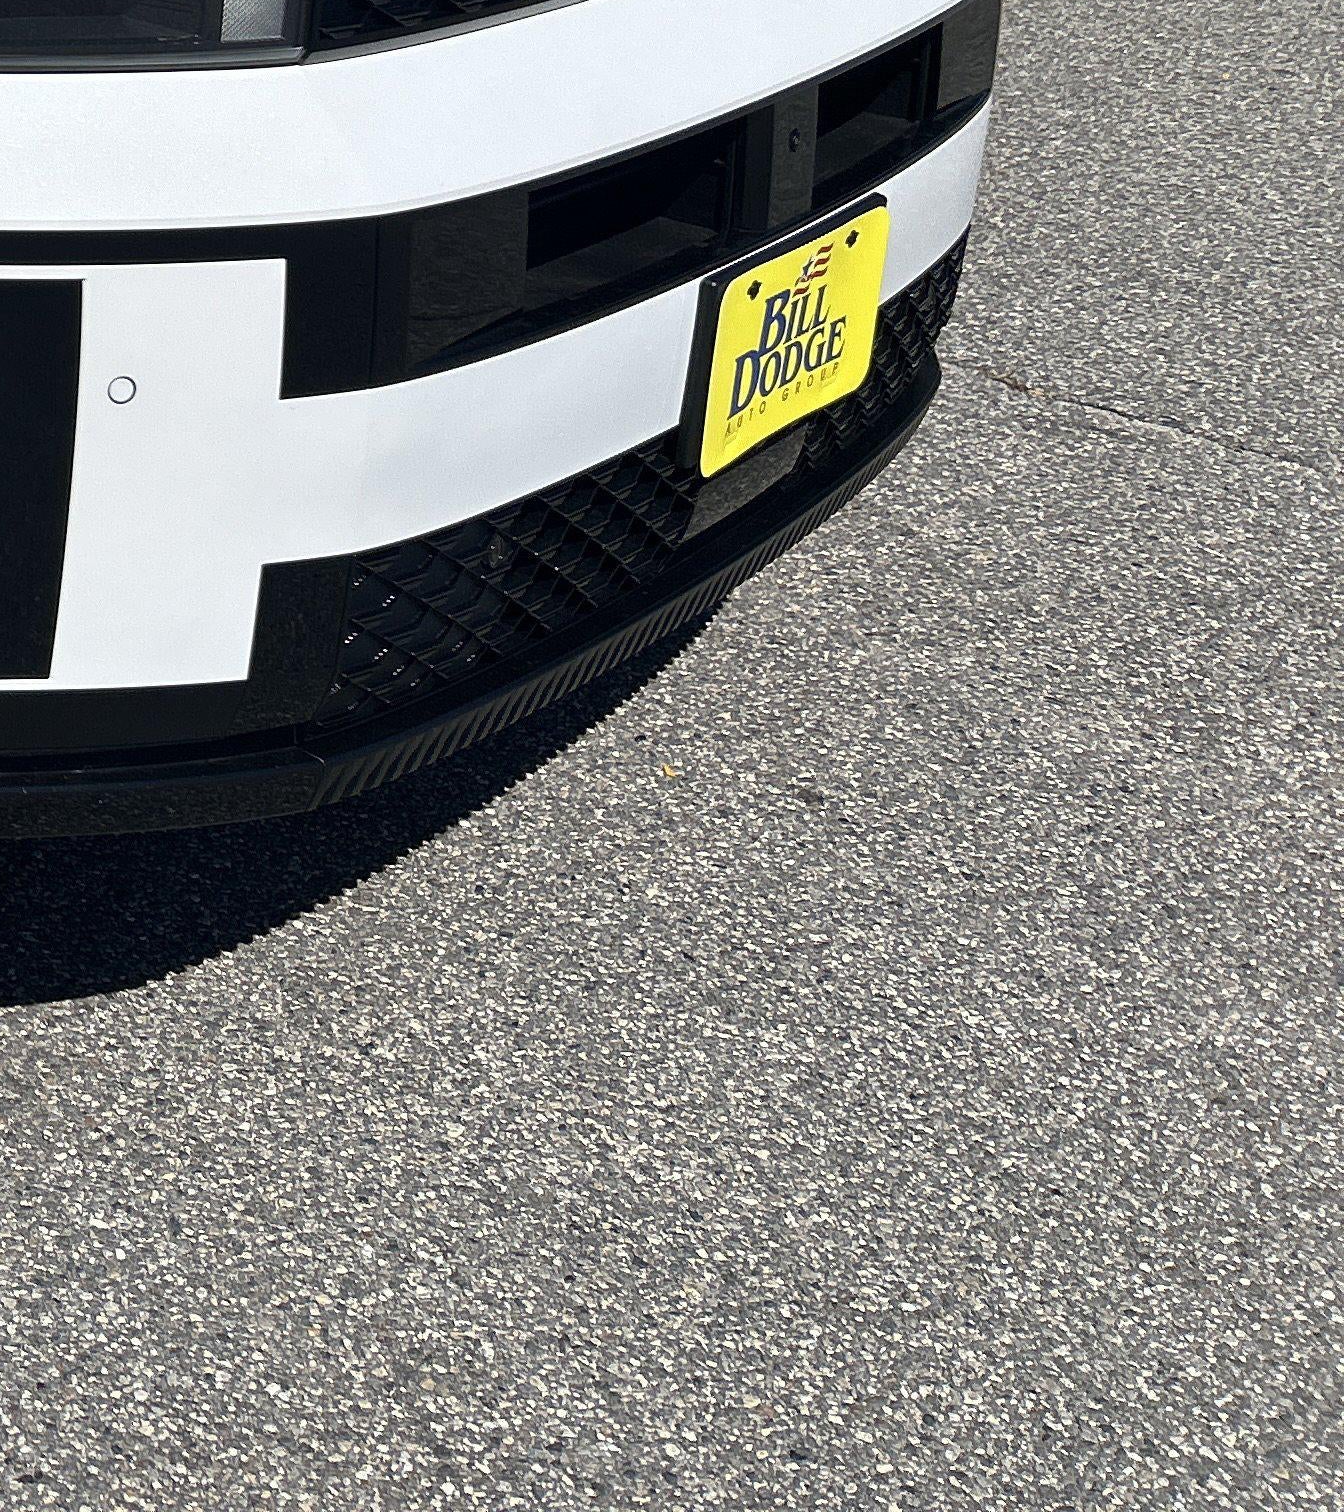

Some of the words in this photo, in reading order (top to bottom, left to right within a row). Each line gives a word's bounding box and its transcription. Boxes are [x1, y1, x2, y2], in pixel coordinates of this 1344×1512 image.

[758, 283, 831, 356] BILL
[724, 400, 767, 436] AUTO
[781, 361, 840, 401] GROUP
[726, 315, 847, 421] DODGE
